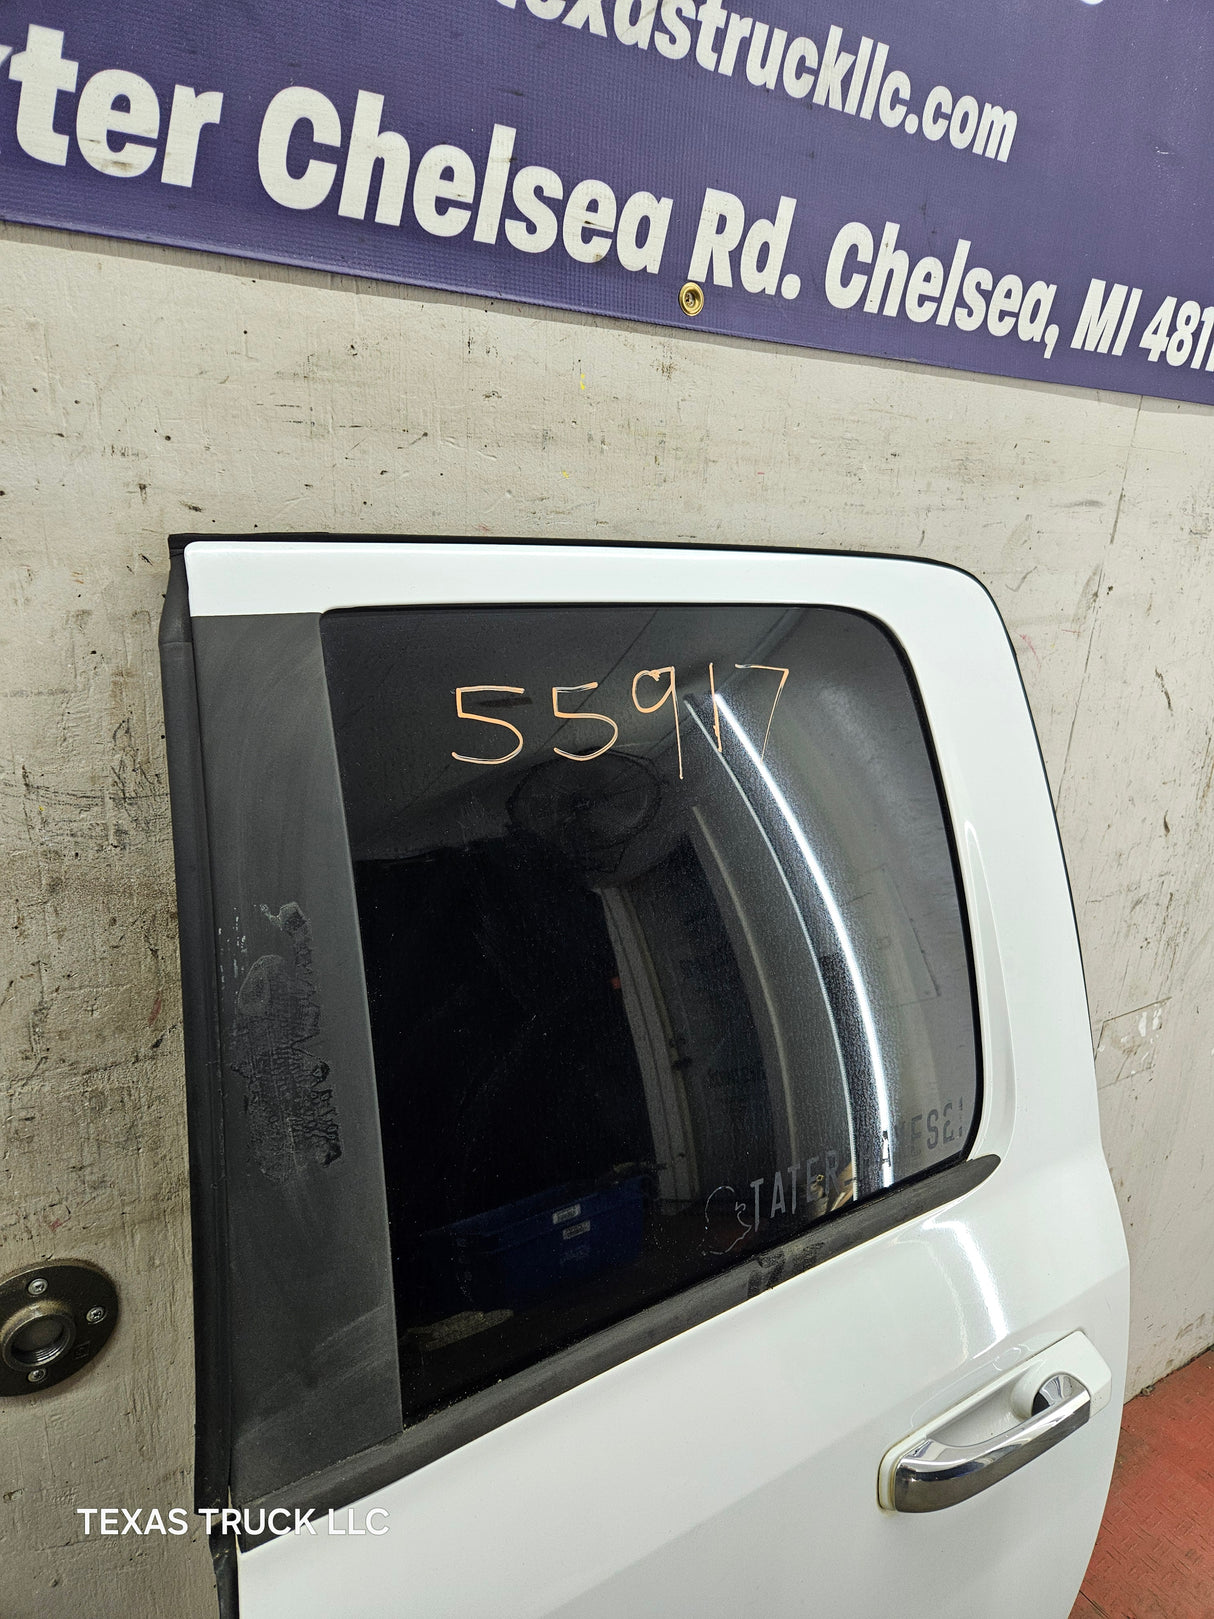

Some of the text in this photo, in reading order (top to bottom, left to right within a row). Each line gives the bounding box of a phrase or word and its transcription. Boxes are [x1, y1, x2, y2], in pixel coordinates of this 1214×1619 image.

[496, 0, 1019, 163] xastruckllc.com
[0, 23, 1214, 372] ter Chelsea Rd. Chelsea, MI 481
[451, 662, 790, 780] 55917
